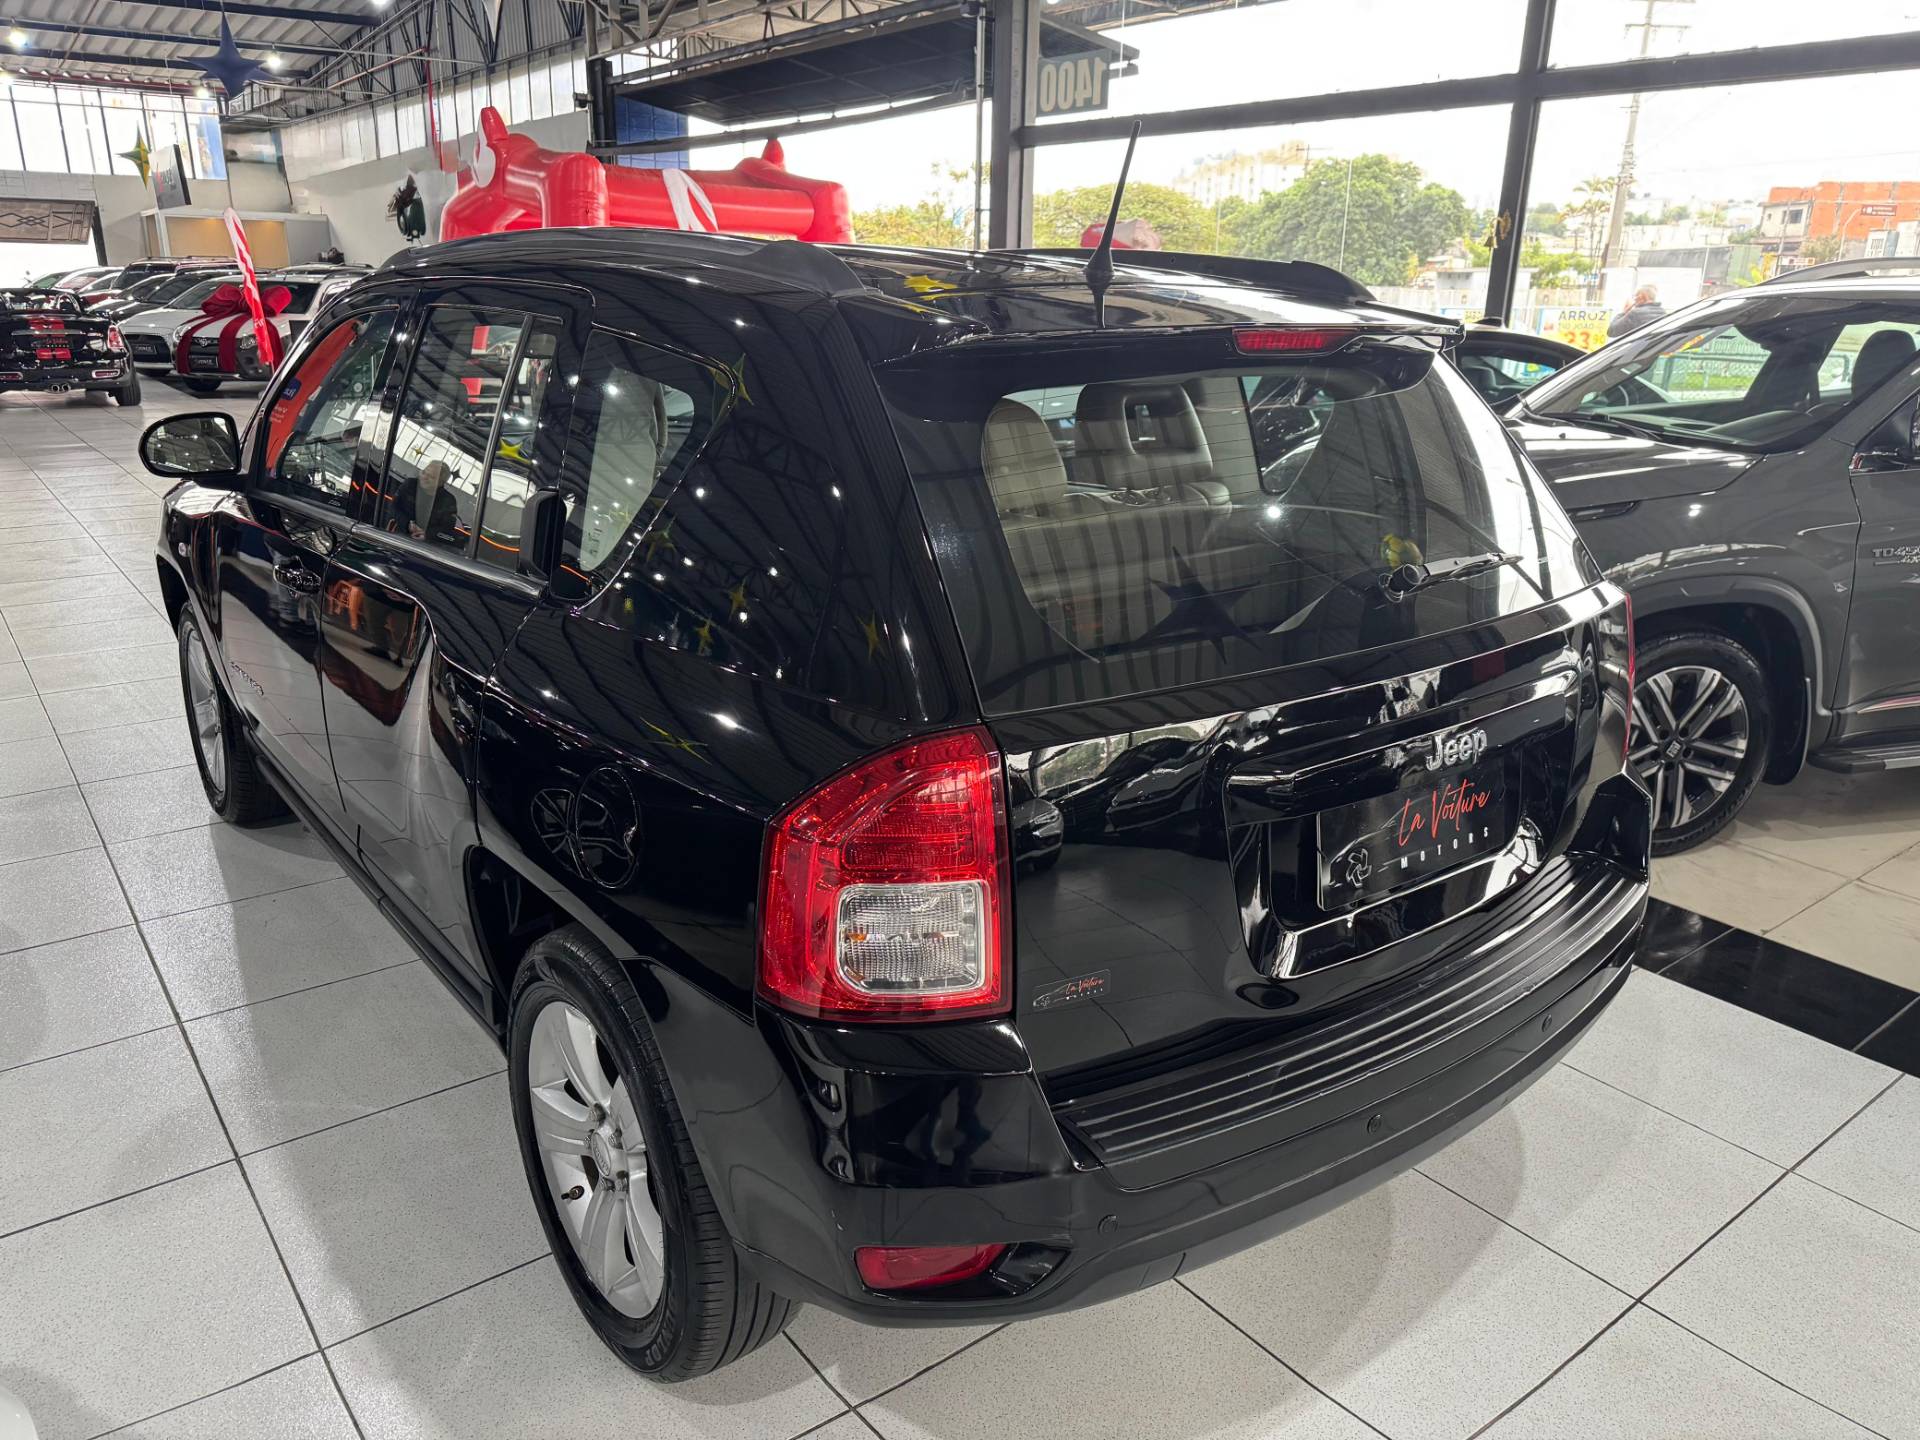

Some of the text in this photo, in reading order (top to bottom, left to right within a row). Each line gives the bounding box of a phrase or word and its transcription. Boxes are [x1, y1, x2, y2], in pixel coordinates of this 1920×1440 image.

[1559, 310, 1607, 321] ARROZ
[1425, 728, 1488, 771] Jeep
[1398, 778, 1492, 847] La Voiture
[1400, 826, 1489, 870] MOTORS
